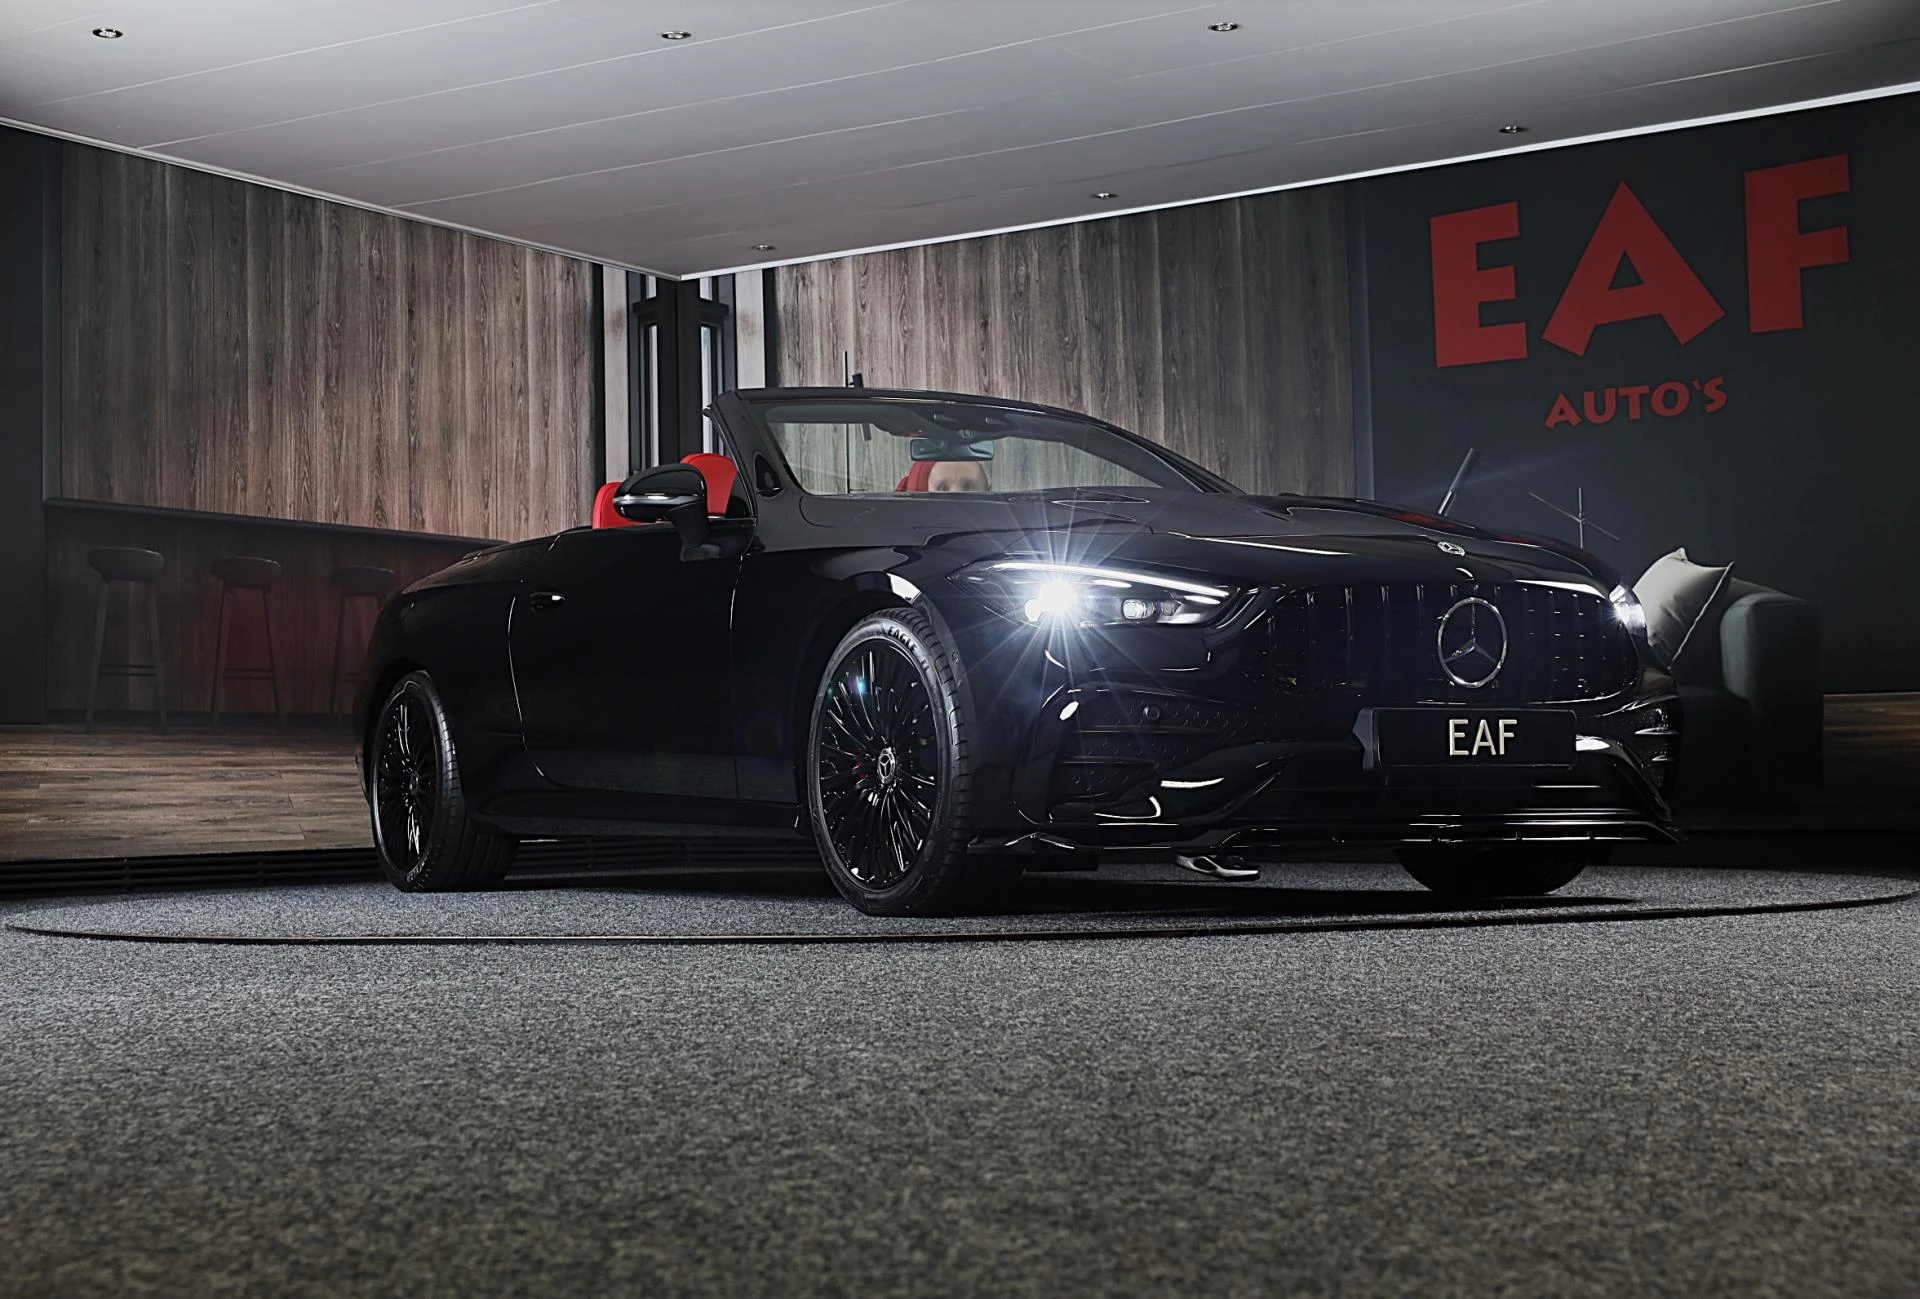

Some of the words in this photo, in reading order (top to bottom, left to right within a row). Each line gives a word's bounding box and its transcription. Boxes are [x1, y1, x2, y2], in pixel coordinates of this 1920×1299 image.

[1430, 153, 1850, 368] EAF
[1544, 376, 1728, 429] AUTO'S
[887, 626, 917, 654] EAGLE
[1449, 719, 1518, 756] EAF
